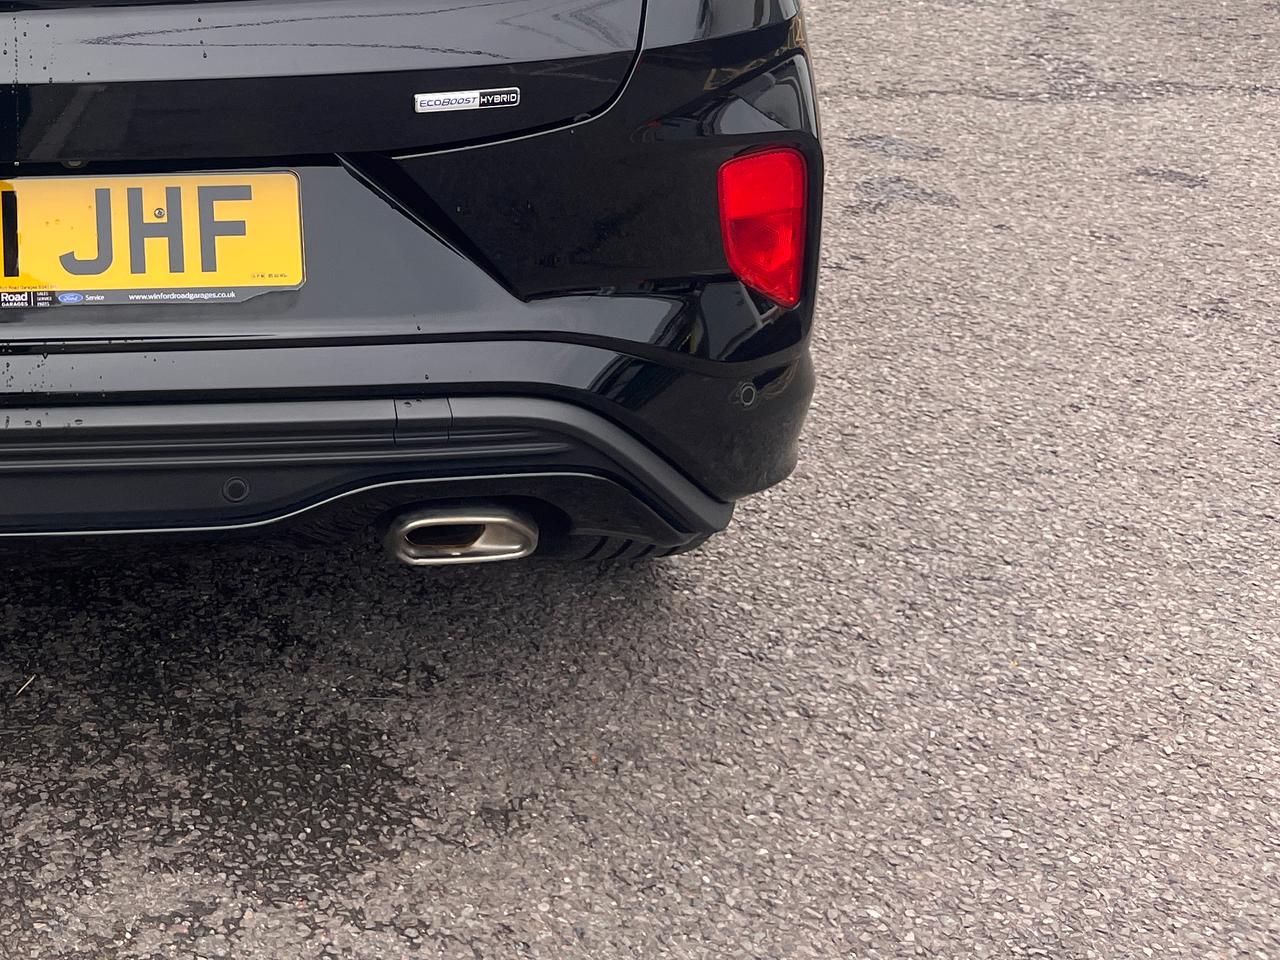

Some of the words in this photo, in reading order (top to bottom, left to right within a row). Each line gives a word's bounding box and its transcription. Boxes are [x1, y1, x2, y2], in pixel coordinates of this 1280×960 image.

[419, 97, 478, 108] ECOBOOST
[480, 93, 517, 105] HYBRID
[59, 185, 252, 275] JHF
[1, 292, 28, 302] Road
[128, 291, 236, 300] www.winfordroadgarages.co.uk
